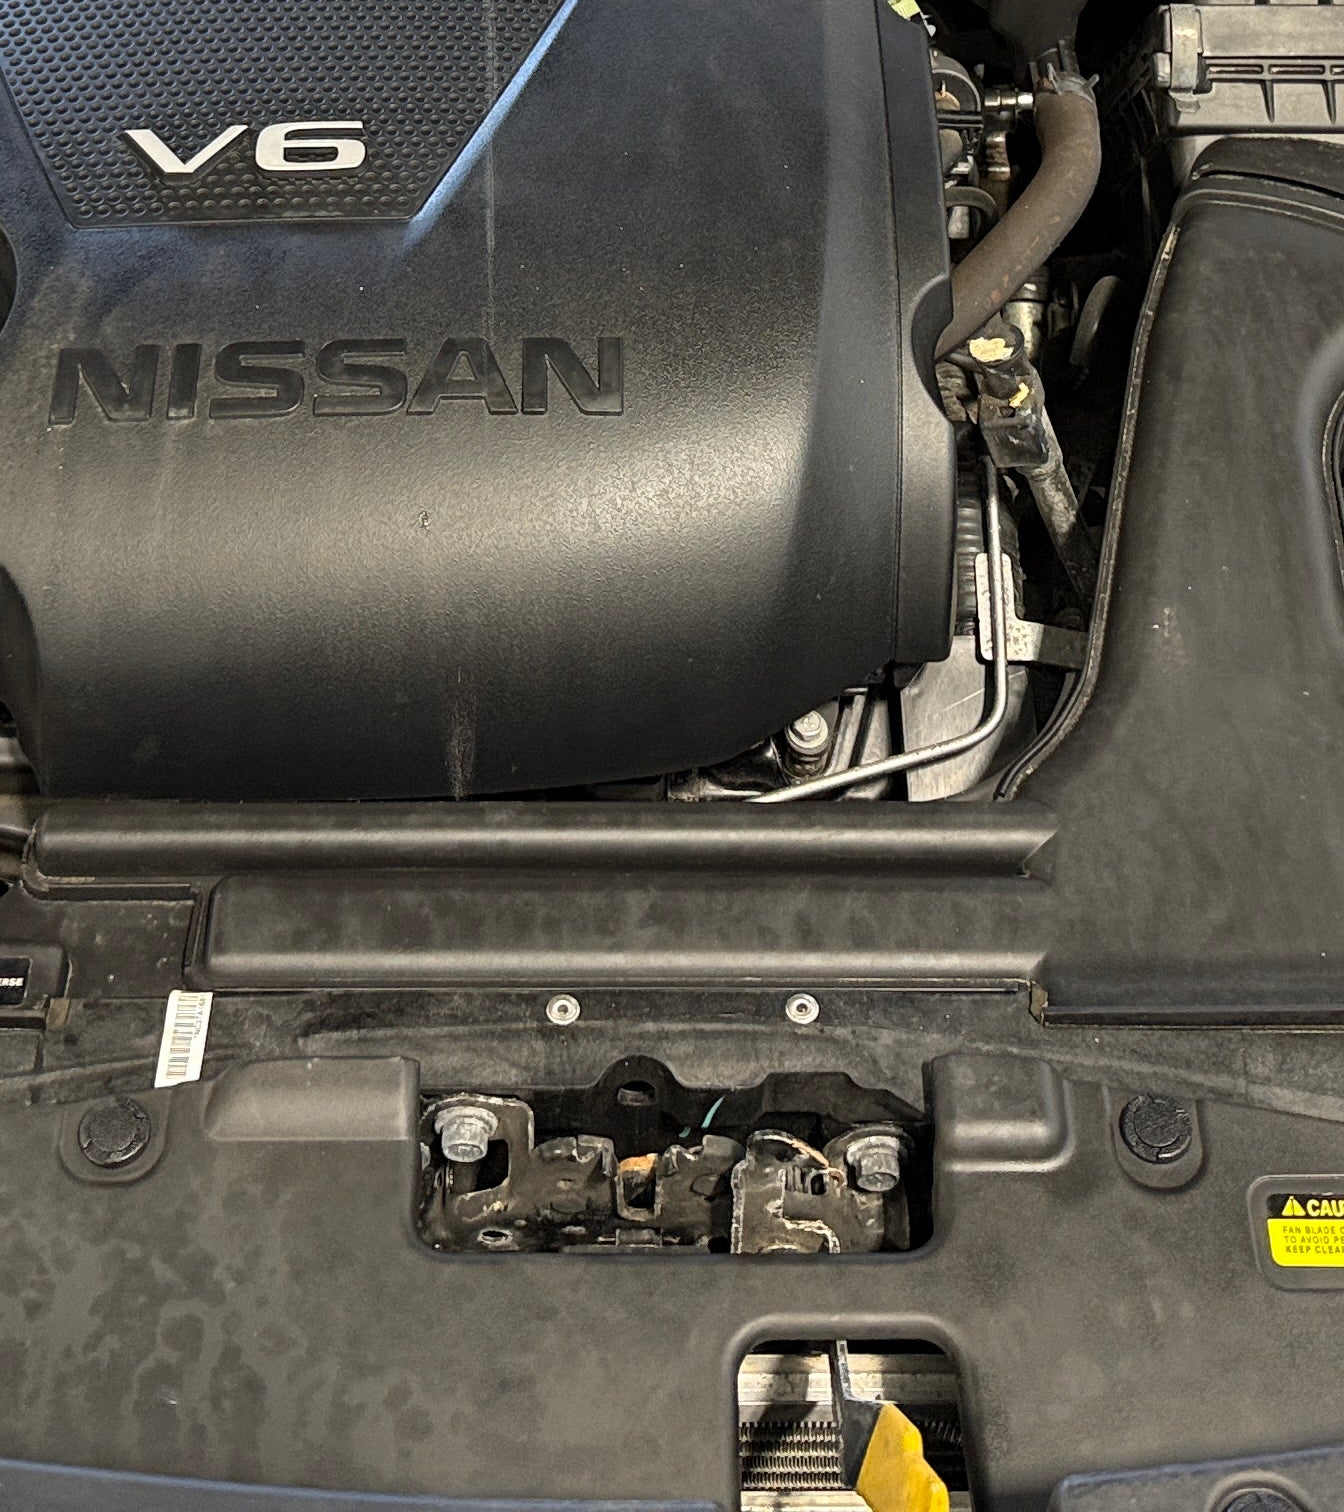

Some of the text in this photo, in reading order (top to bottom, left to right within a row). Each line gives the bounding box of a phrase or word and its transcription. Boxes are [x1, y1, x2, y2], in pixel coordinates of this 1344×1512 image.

[123, 120, 367, 175] V6
[48, 336, 625, 426] NISSAN
[1282, 1225, 1302, 1235] FAN
[1305, 1225, 1336, 1235] BLADE
[1284, 1235, 1297, 1244] TO
[1300, 1235, 1330, 1245] AVOID
[1285, 1245, 1311, 1254] KEEP
